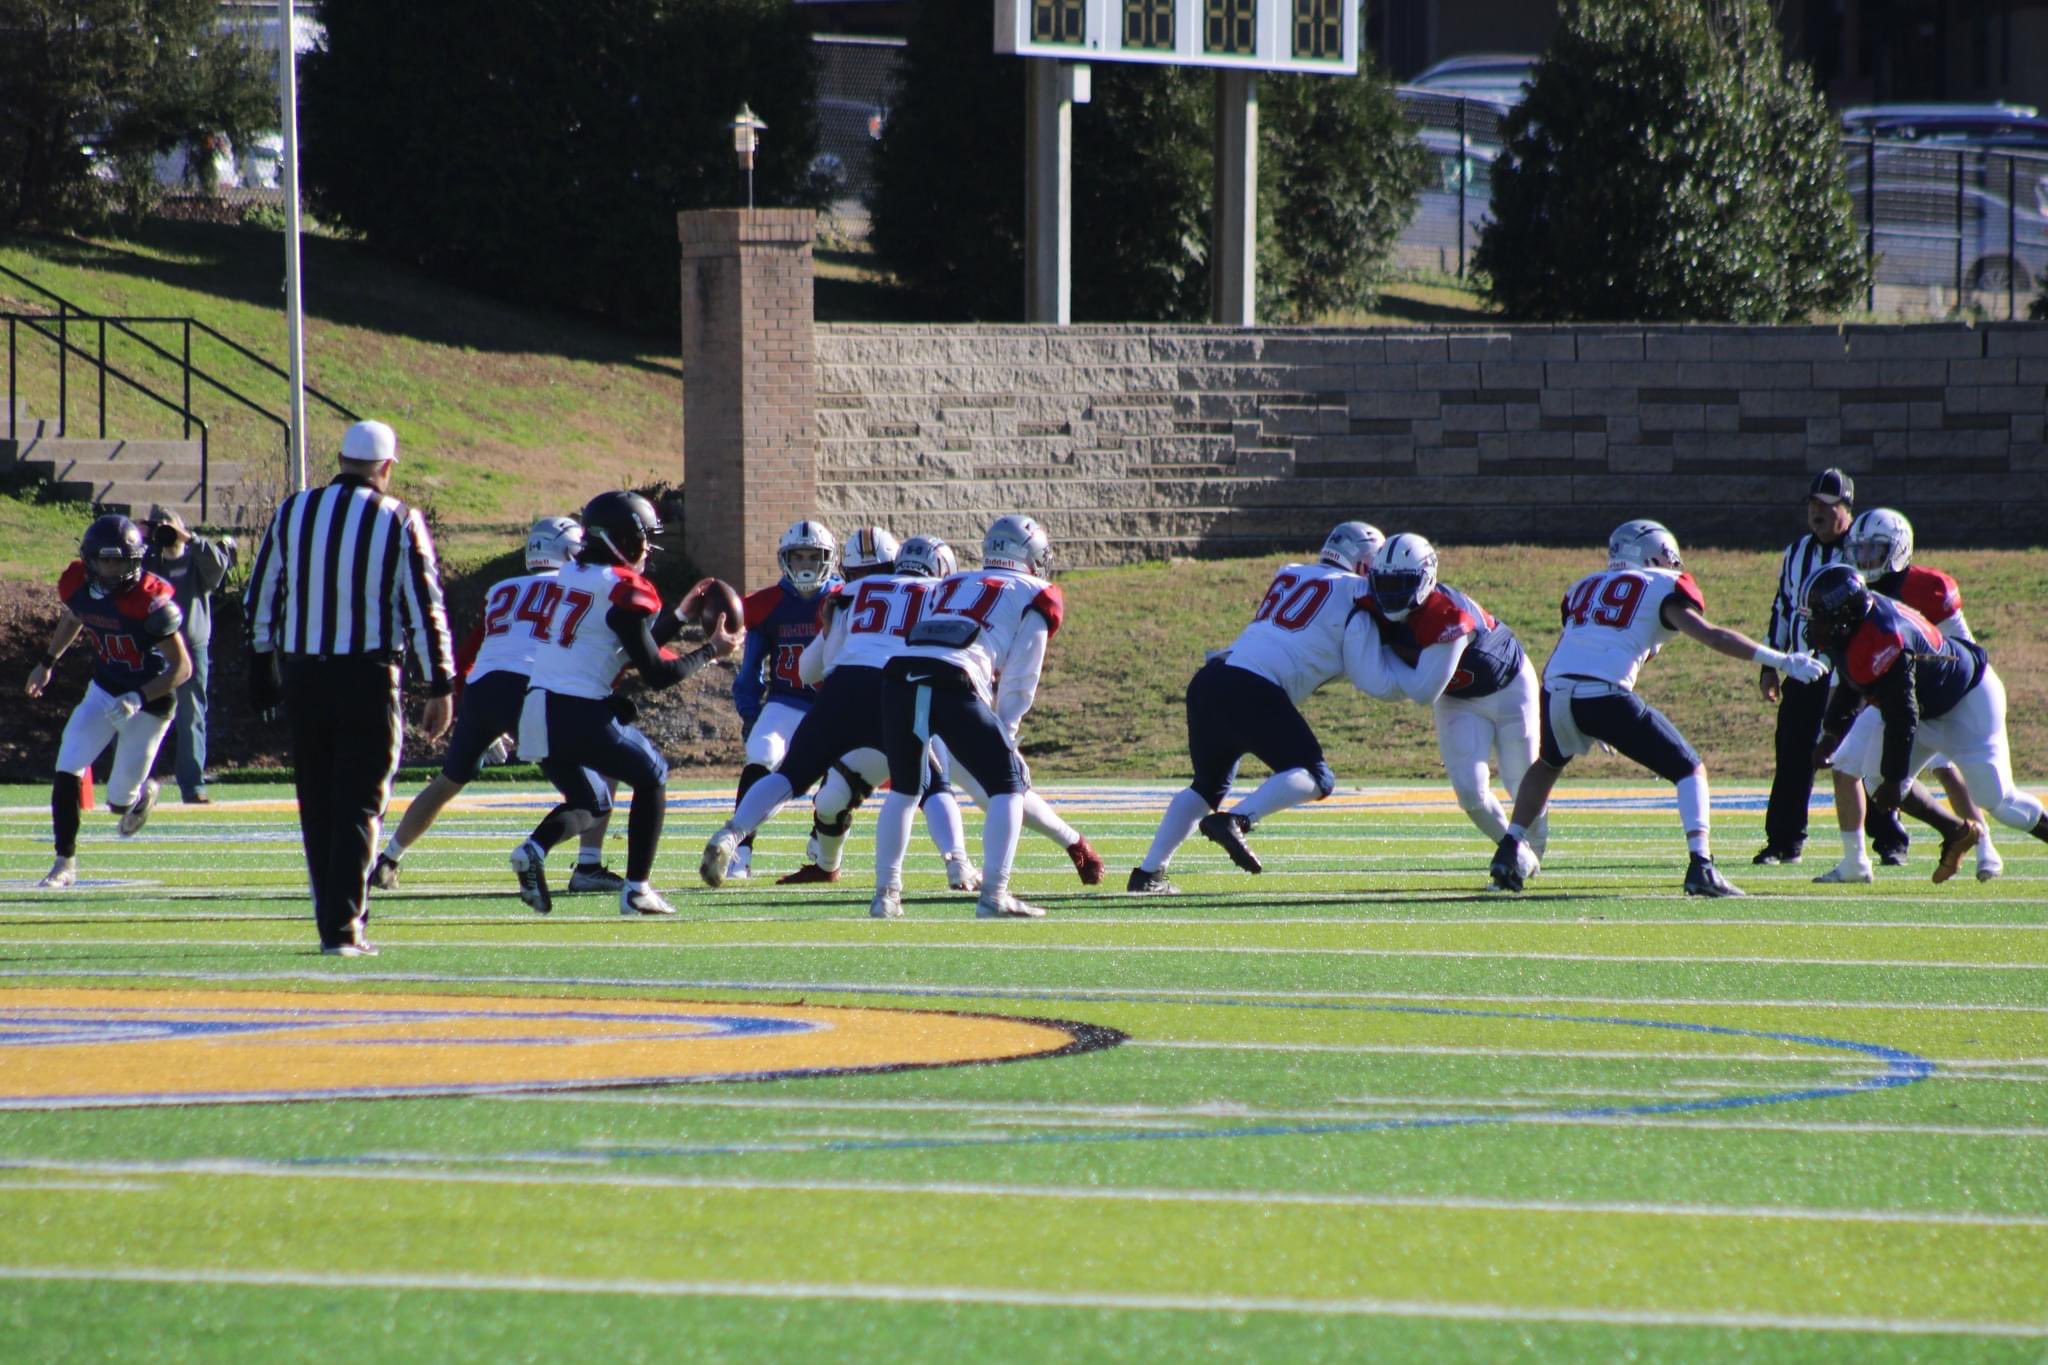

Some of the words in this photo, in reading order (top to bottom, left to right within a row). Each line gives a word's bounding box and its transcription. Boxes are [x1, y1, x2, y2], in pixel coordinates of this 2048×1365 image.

[485, 579, 561, 643] 24
[851, 580, 930, 637] 51
[1255, 573, 1333, 633] 60
[1567, 574, 1649, 631] 49
